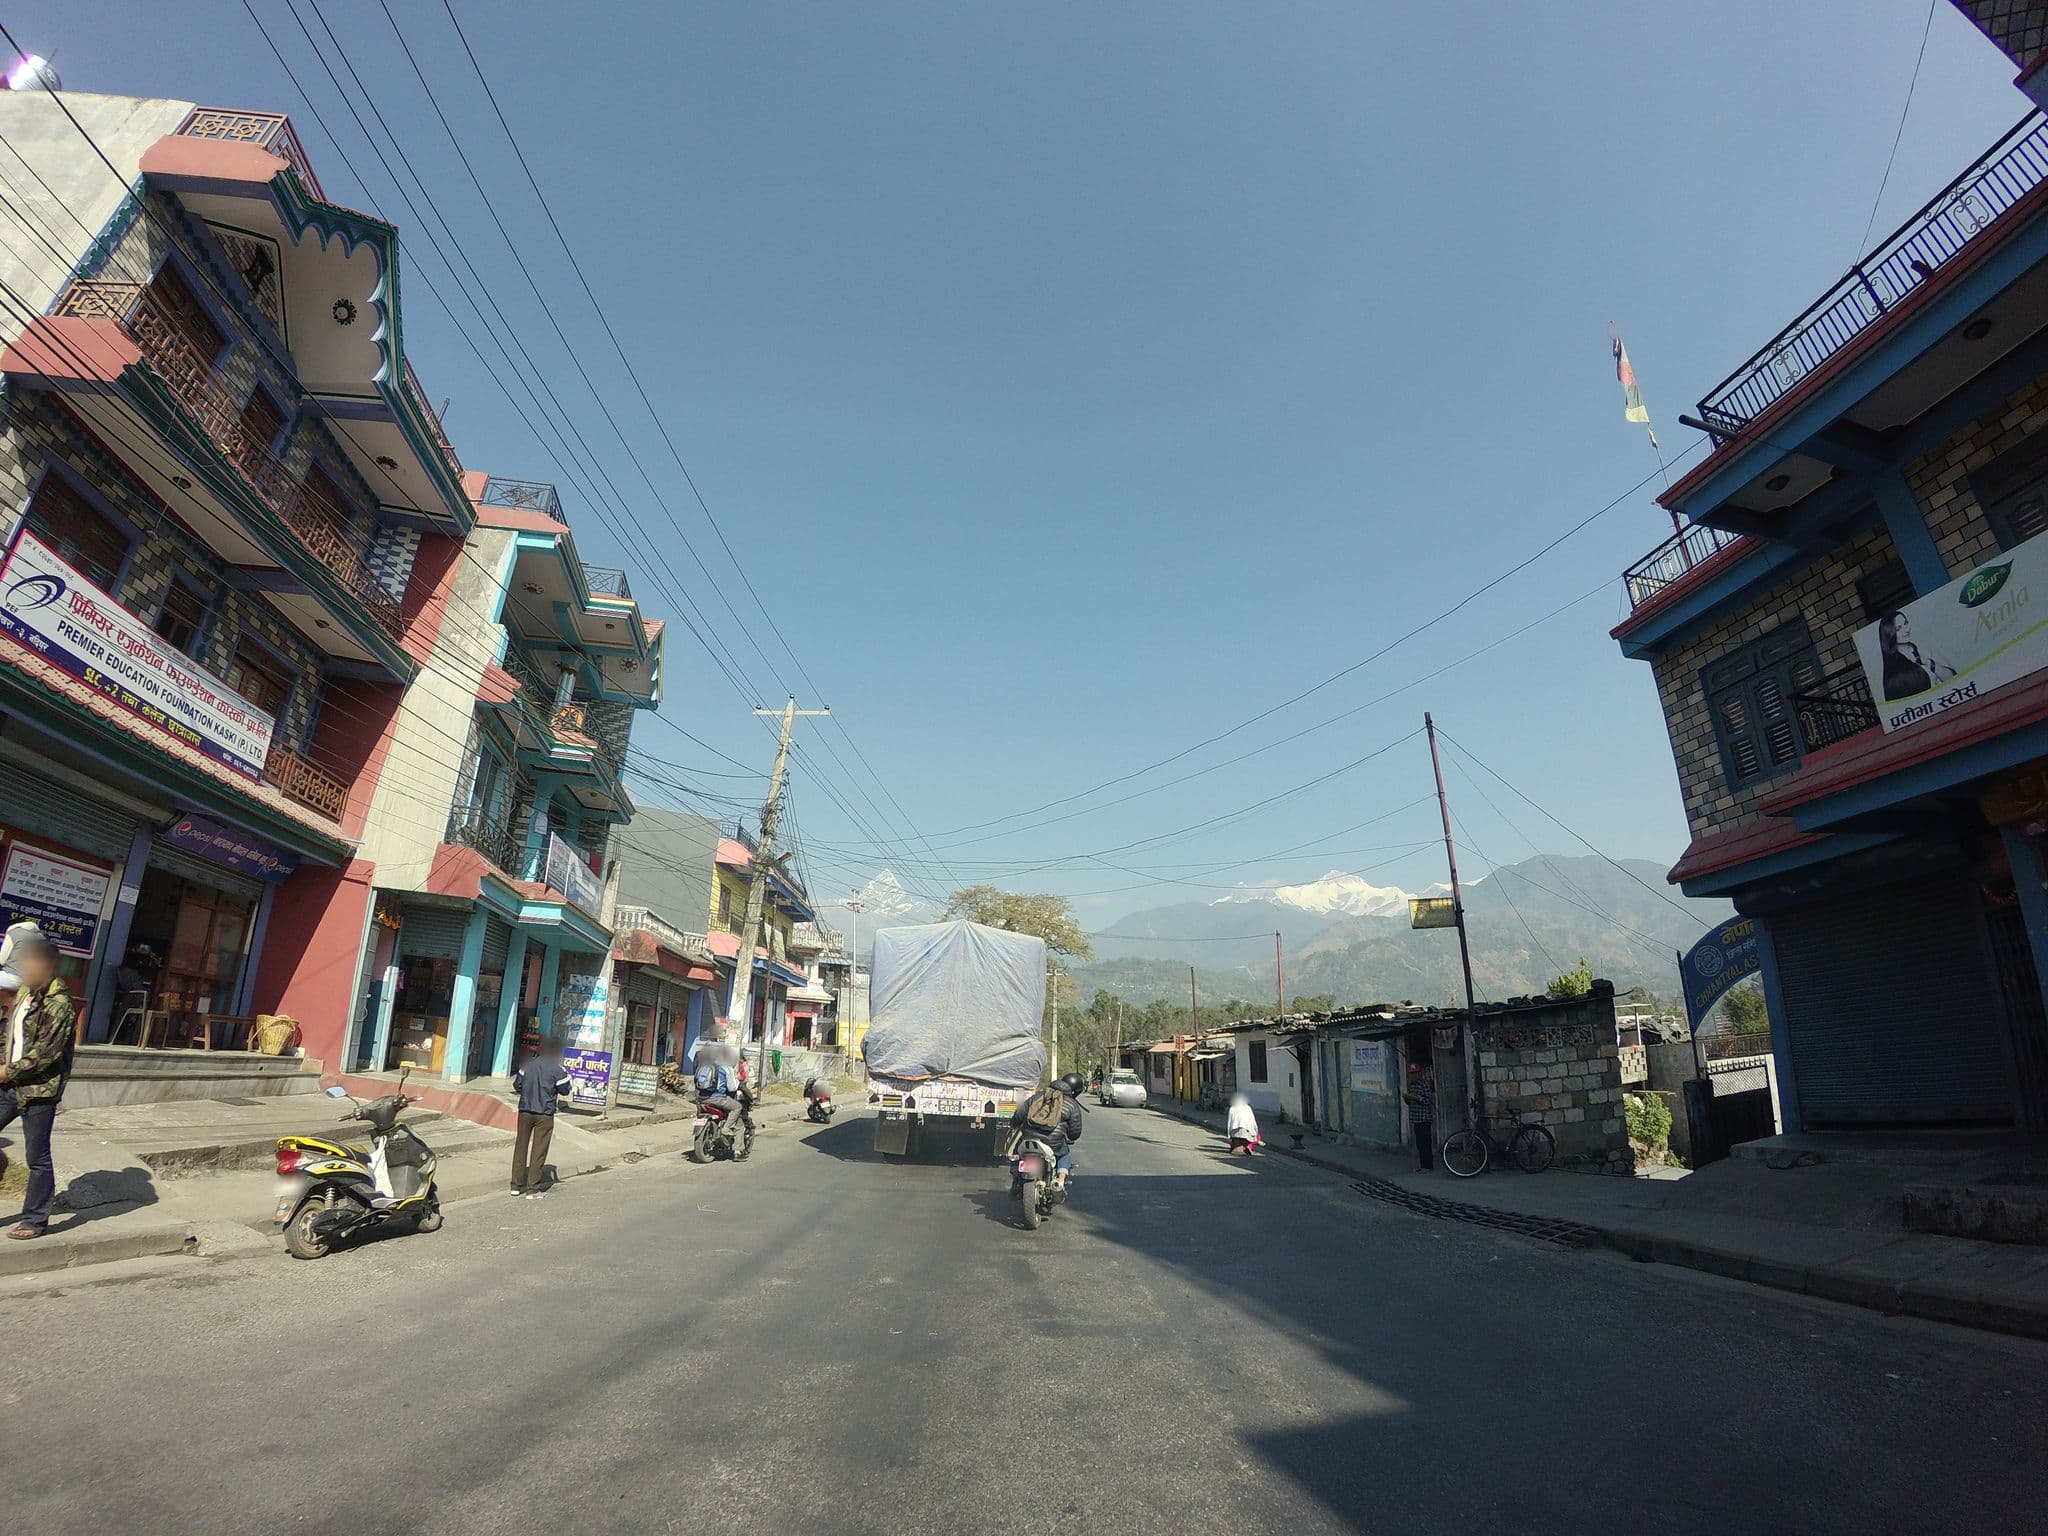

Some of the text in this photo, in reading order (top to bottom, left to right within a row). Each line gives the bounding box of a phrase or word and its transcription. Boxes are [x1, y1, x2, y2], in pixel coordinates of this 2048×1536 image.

[1967, 572, 1999, 602] Dabur
[68, 591, 116, 638] प्रिमियर
[117, 629, 165, 671] एजुकेशन
[217, 701, 246, 726] कास्की
[57, 619, 105, 661] PREMIER
[105, 652, 161, 696] EDUCATION
[160, 688, 214, 730] FOUNDATION
[214, 722, 238, 745] KASKI
[1937, 680, 1977, 708] स्टोर्स
[104, 684, 119, 698] +2
[120, 690, 141, 710] तथा
[188, 829, 213, 843] pepsi
[44, 921, 56, 931] +2
[58, 922, 83, 936] होस्टेल
[585, 1059, 610, 1073] पार्लर
